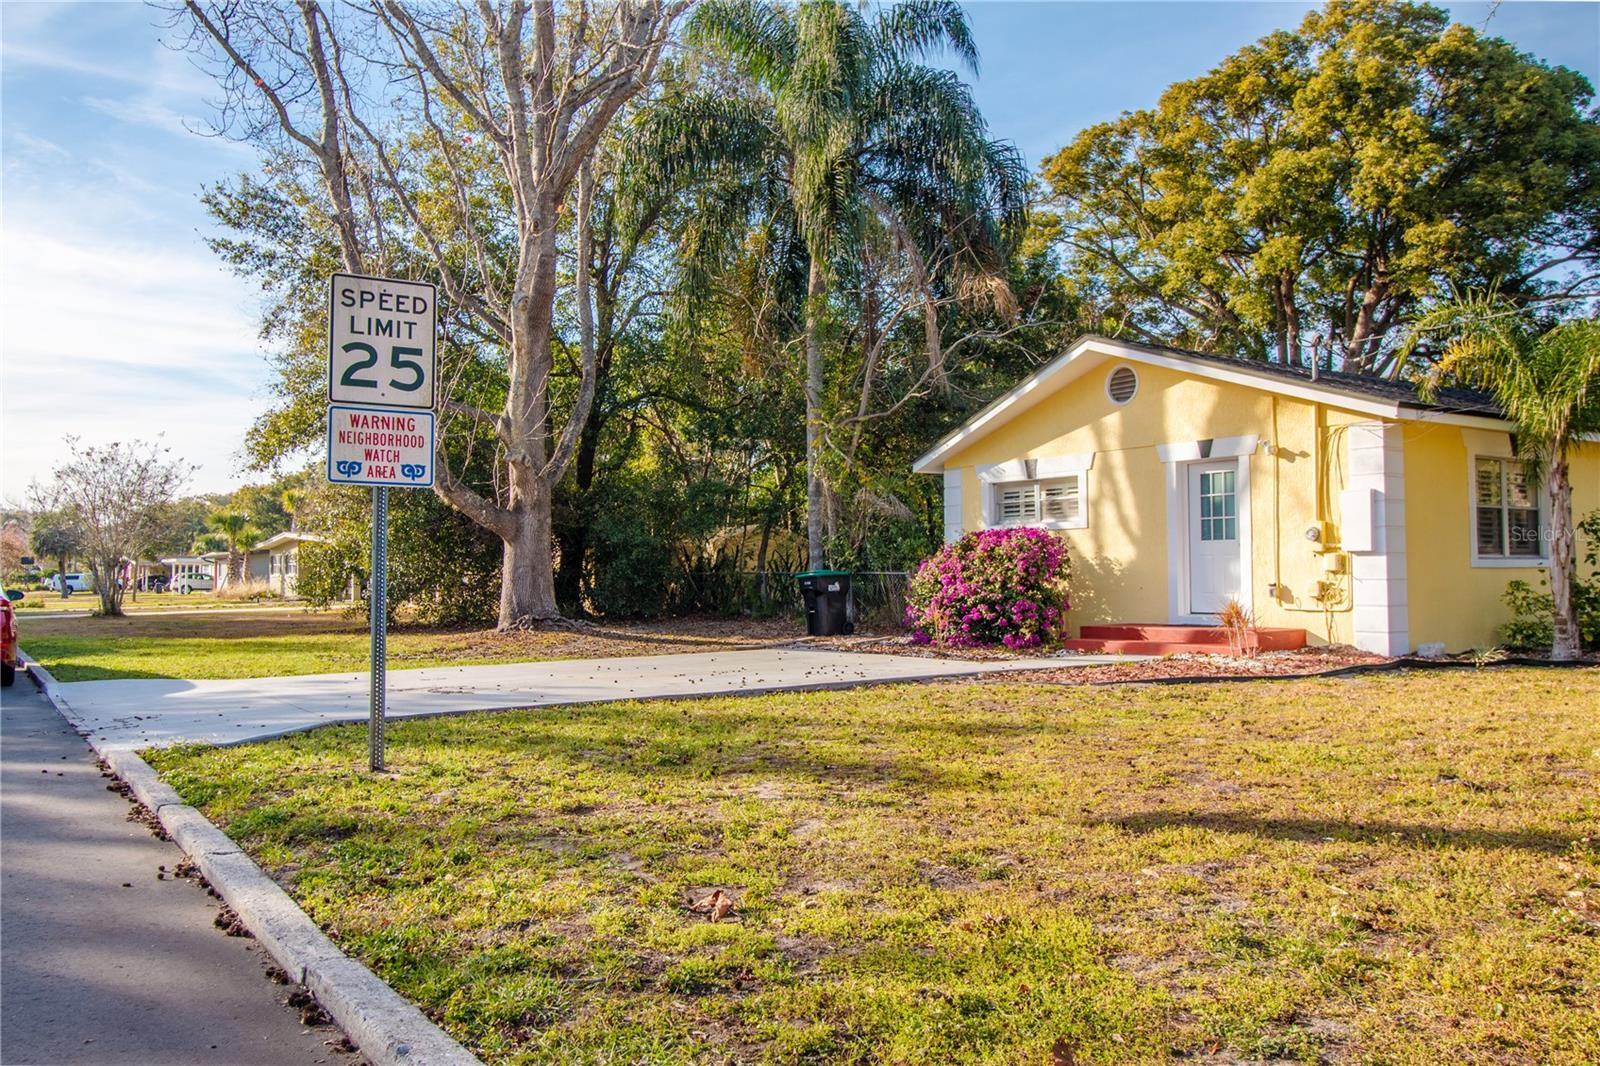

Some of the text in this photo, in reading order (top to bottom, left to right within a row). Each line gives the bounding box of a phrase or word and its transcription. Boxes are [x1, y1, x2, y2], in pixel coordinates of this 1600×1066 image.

[341, 288, 428, 315] SPEED
[350, 315, 417, 340] LIMIT
[340, 341, 425, 392] 25
[350, 413, 416, 432] WARNING
[338, 430, 425, 448] NEIGHBORHOOD
[364, 448, 400, 463] WATCH
[366, 465, 397, 479] AREA
